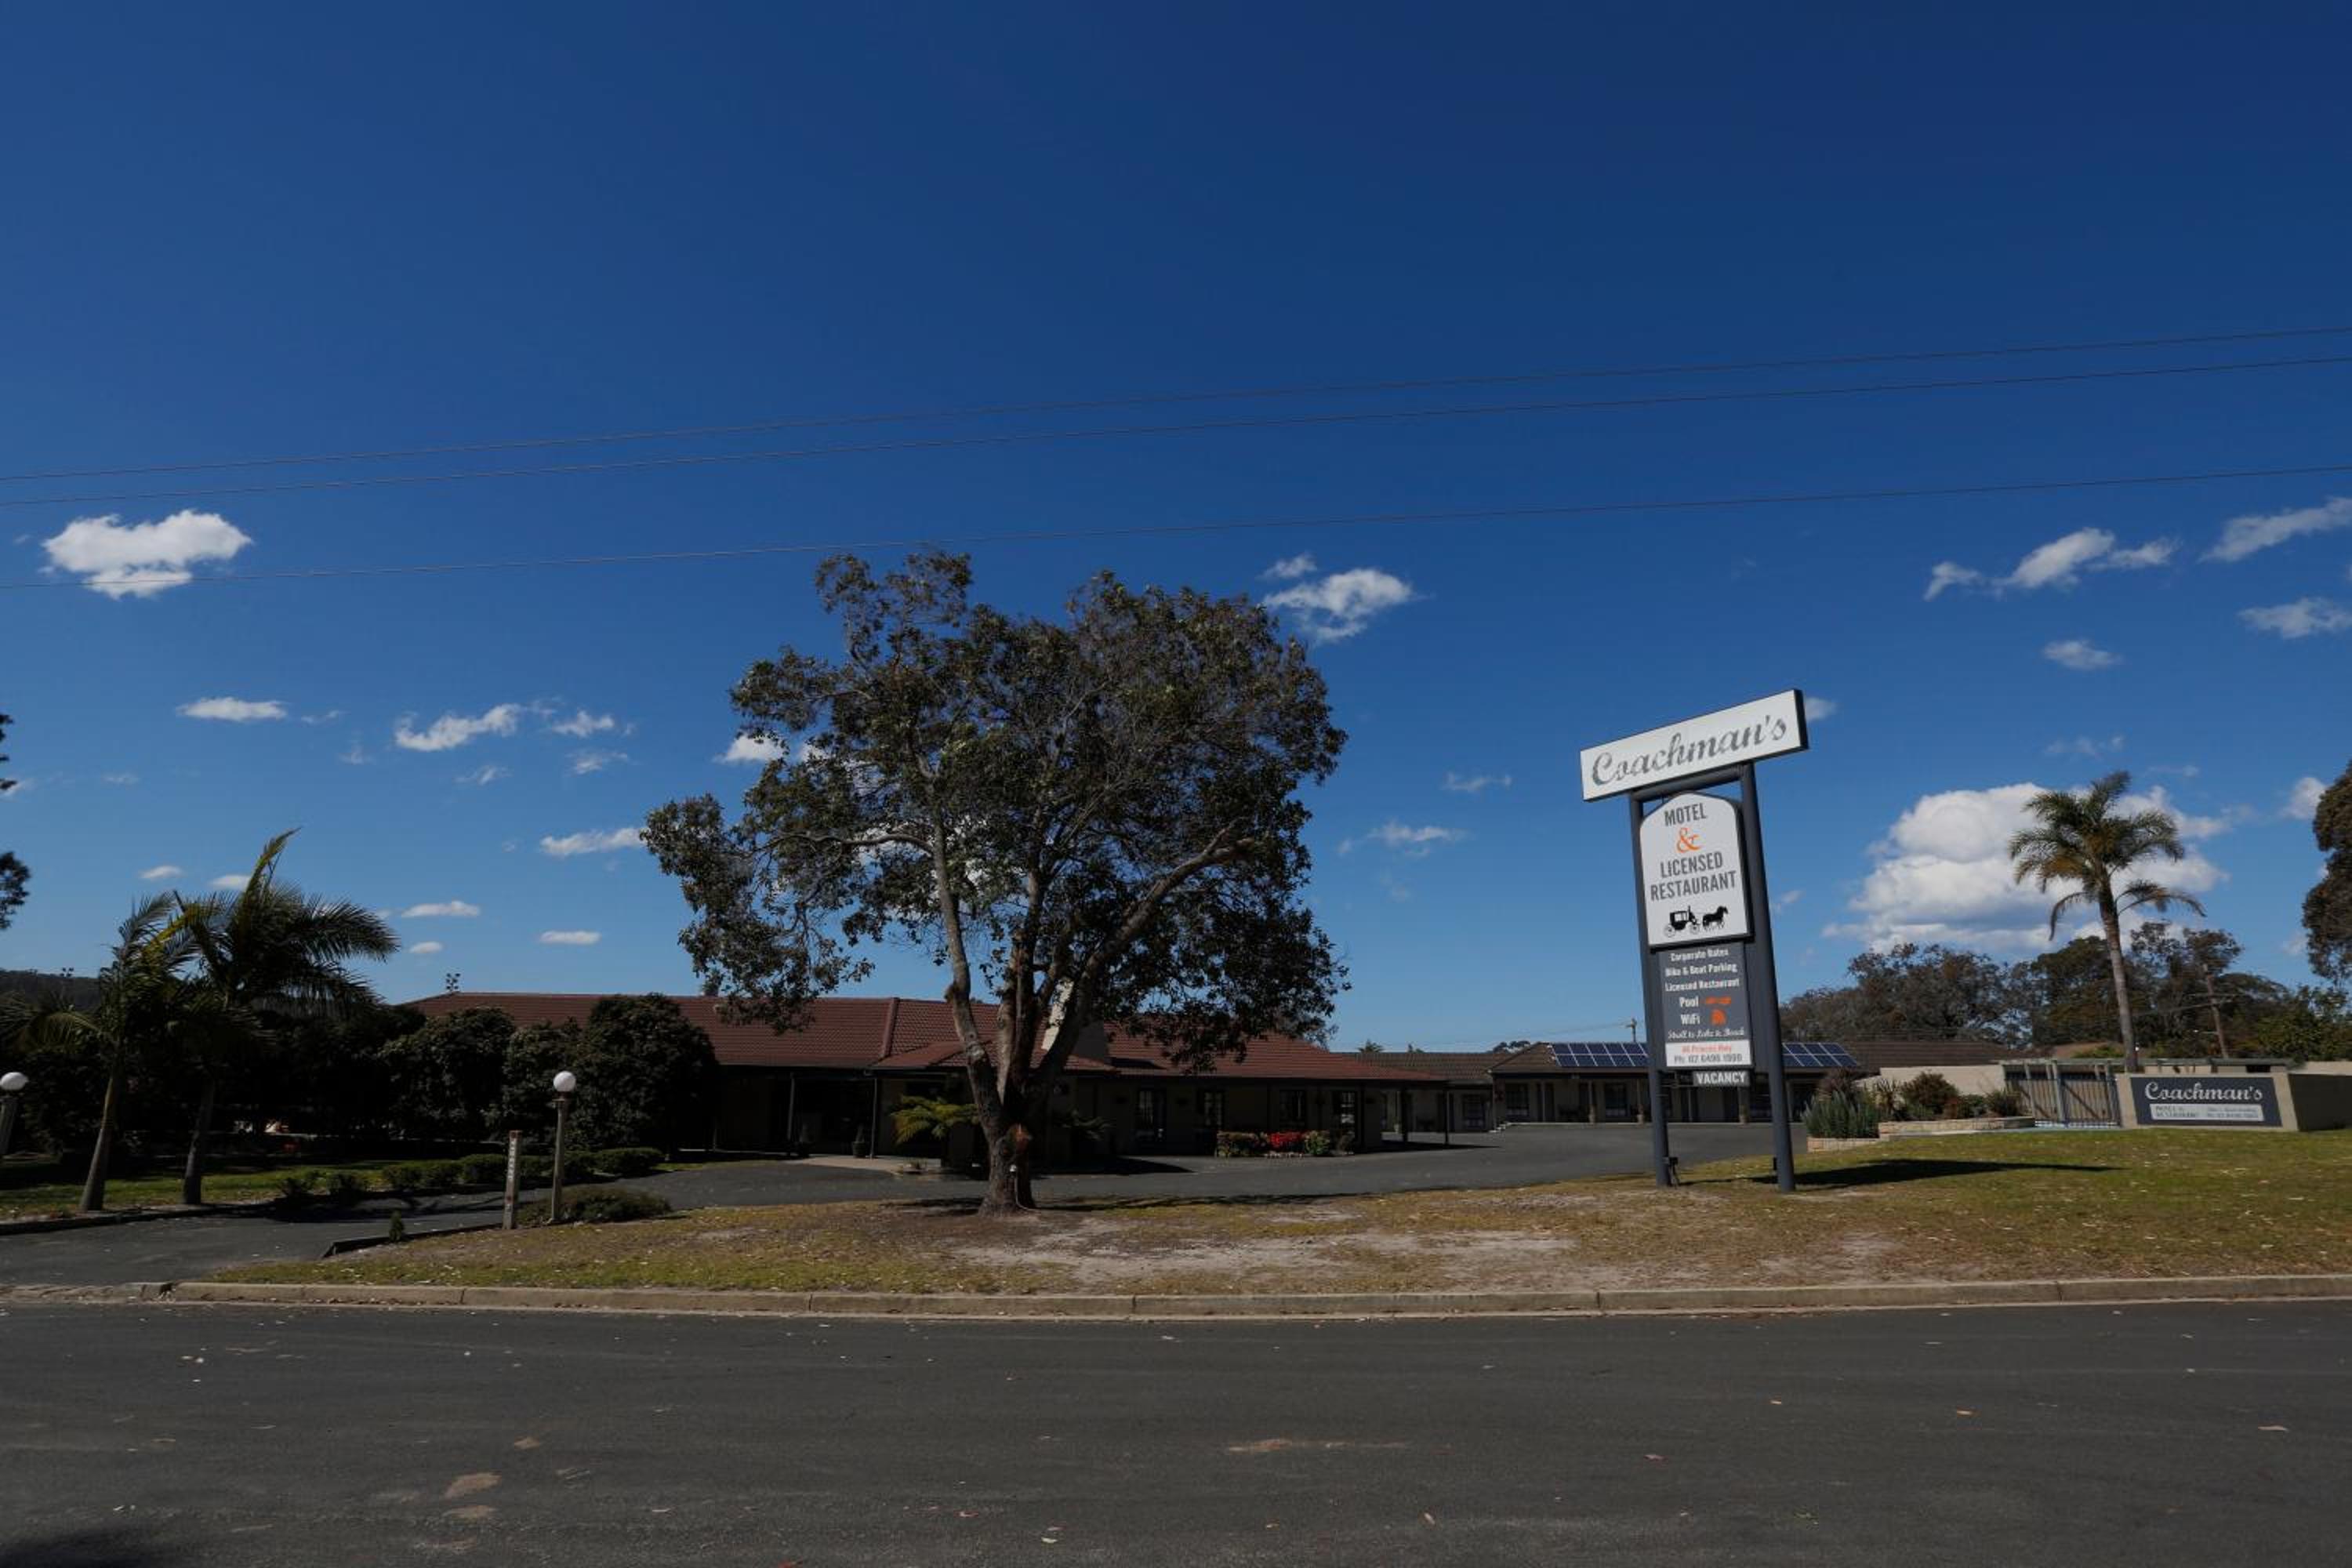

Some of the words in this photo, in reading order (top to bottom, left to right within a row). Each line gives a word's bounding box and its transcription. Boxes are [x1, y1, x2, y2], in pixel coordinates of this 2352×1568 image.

[1592, 715, 1787, 786] Coachman's
[1664, 803, 1707, 826] MOTEL
[1676, 827, 1702, 853] &
[1661, 851, 1722, 878] LICENSED
[1650, 870, 1737, 901] RESTAURANT
[1708, 963, 1738, 973] Parking
[1664, 981, 1697, 992] Licensed
[1699, 978, 1739, 989] Restaurant
[1679, 996, 1699, 1007] Pool
[1681, 1013, 1700, 1025] WiFi
[1696, 1071, 1747, 1084] VACANCY
[2145, 1082, 2263, 1101] Coachman's
